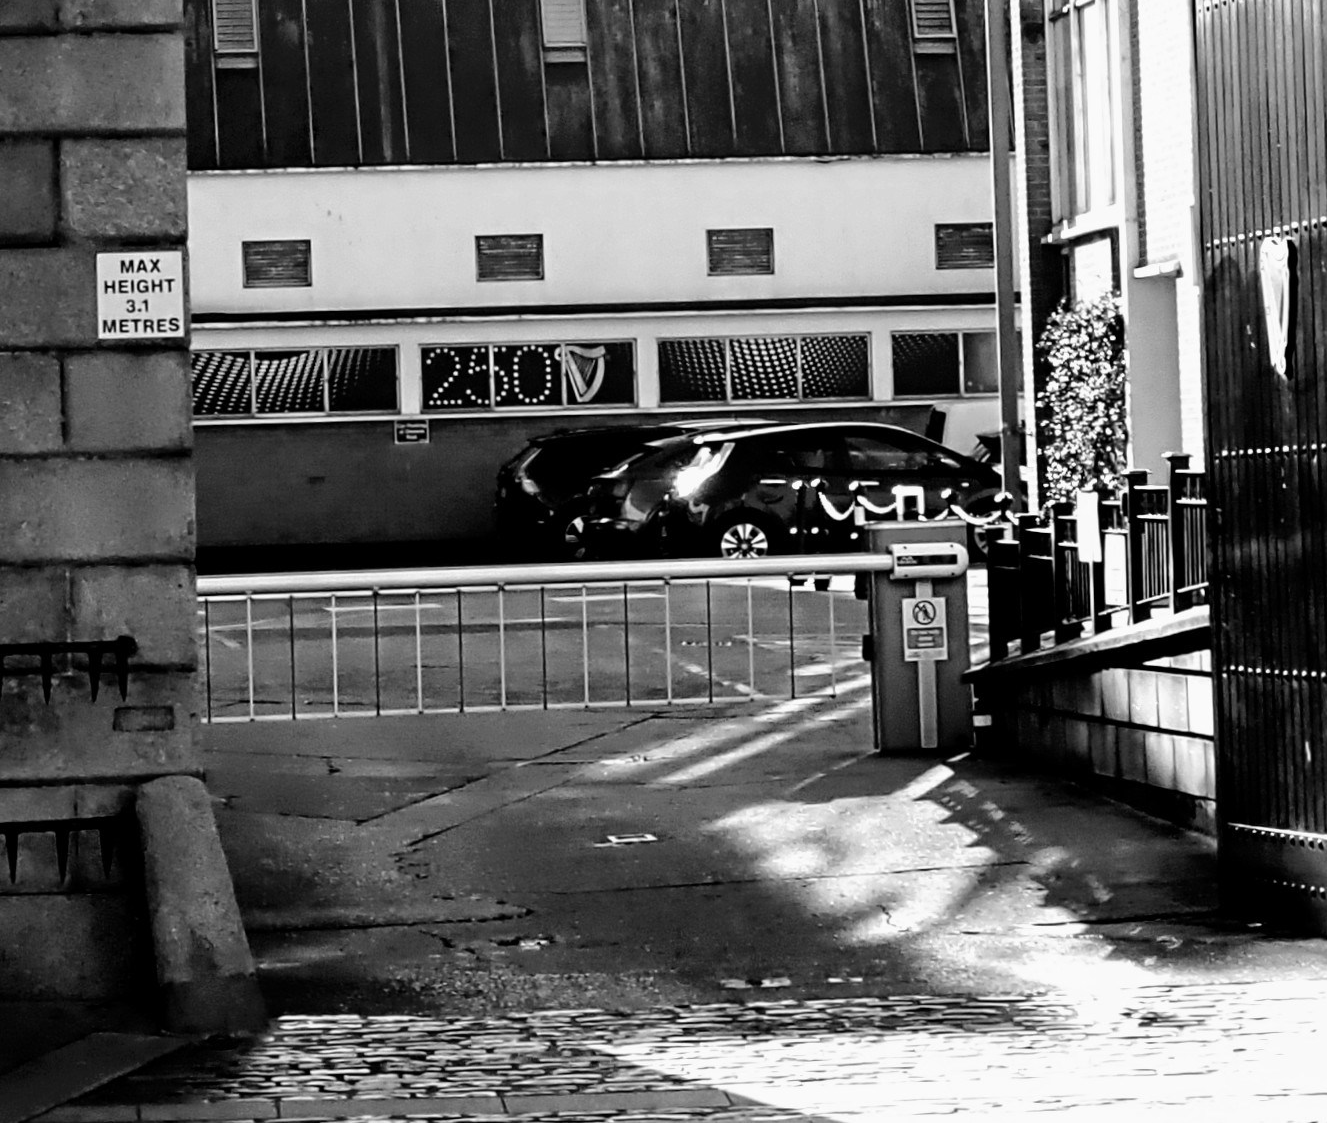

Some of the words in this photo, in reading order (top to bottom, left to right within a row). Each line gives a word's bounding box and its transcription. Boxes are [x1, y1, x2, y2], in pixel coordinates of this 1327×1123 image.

[120, 258, 161, 274] MAX
[103, 278, 176, 294] HEIGHT
[125, 298, 149, 314] 3.1
[102, 317, 180, 334] METRES
[426, 344, 552, 406] 250
